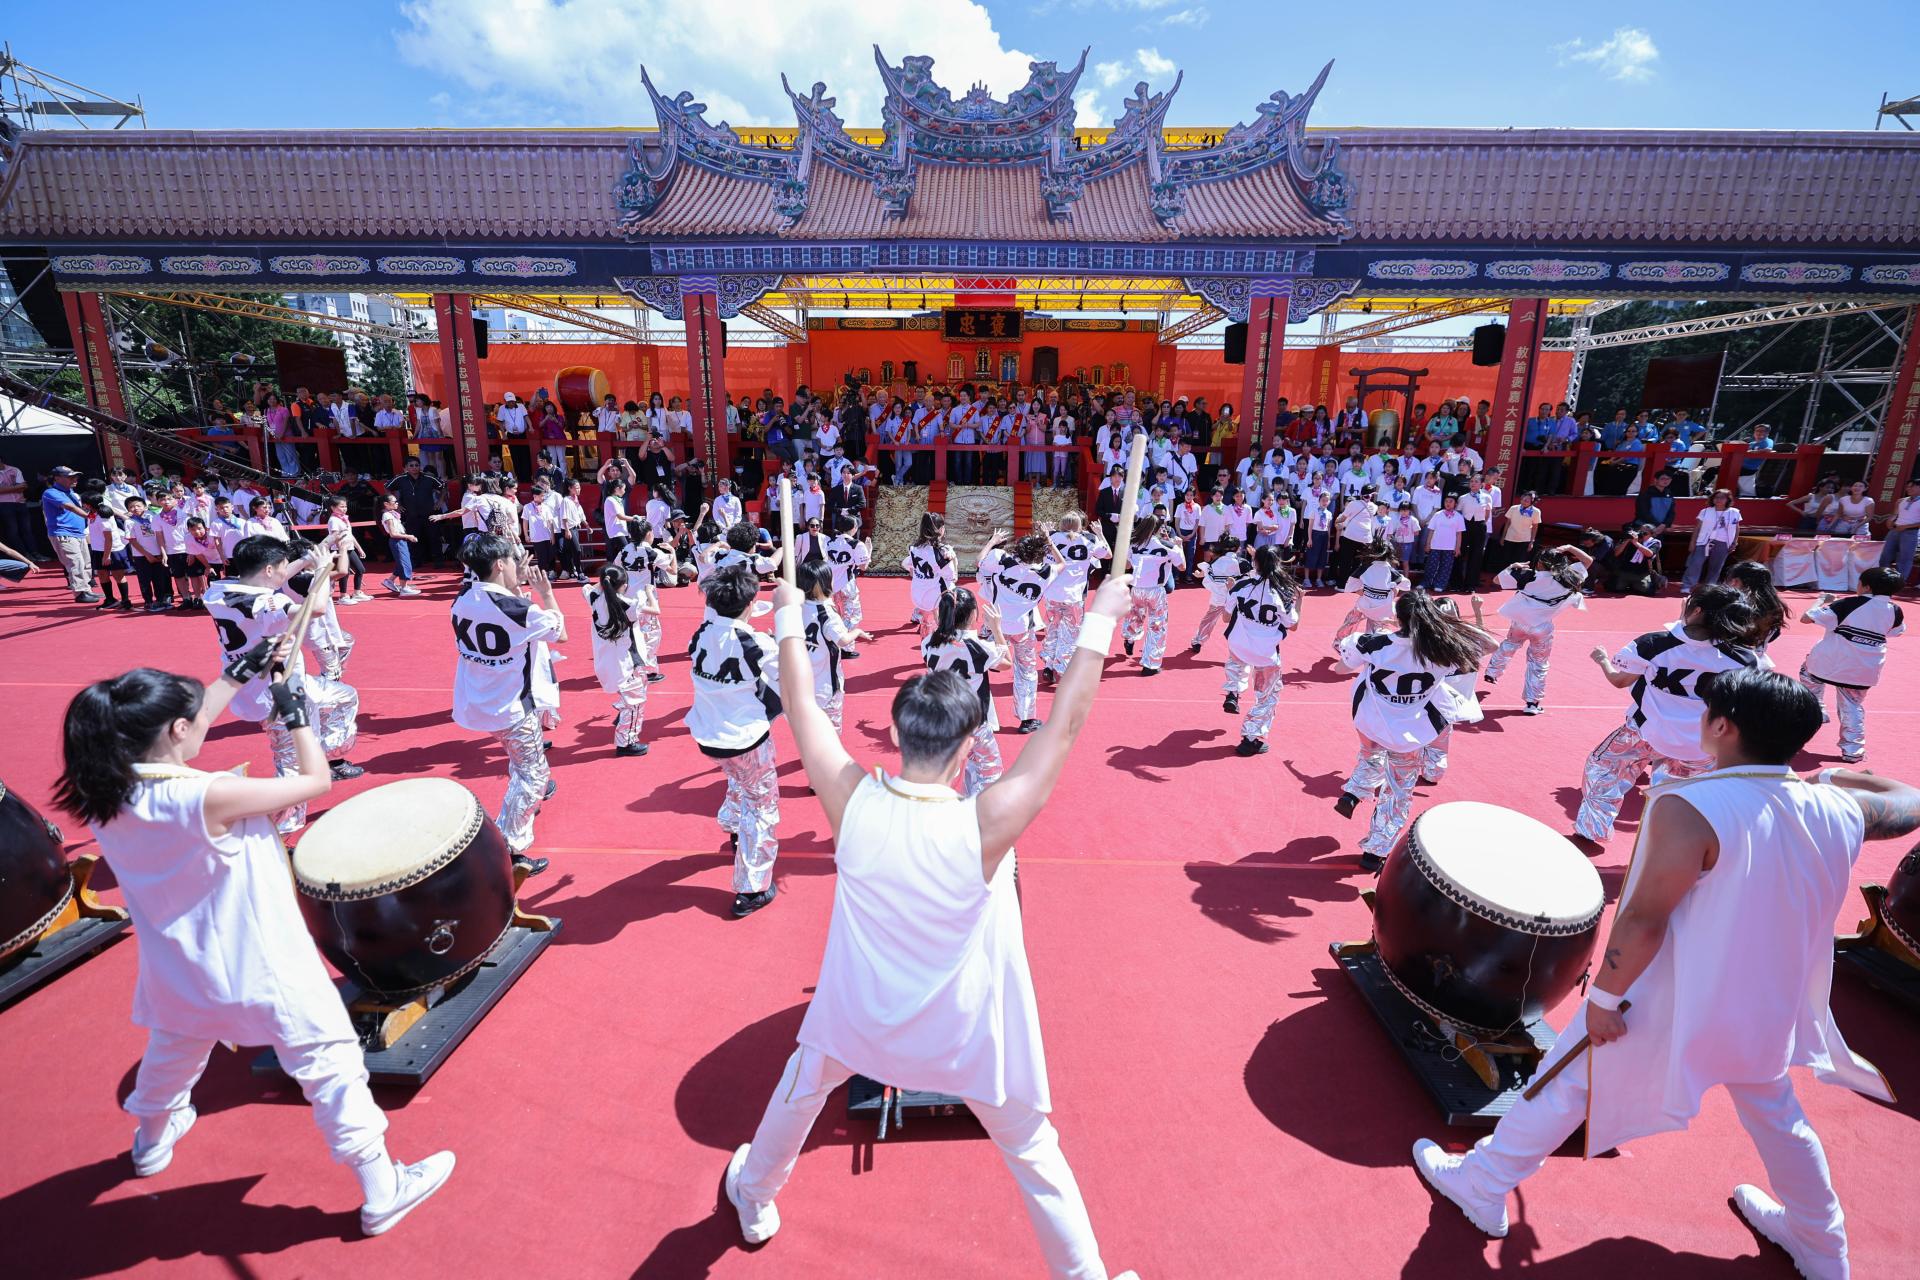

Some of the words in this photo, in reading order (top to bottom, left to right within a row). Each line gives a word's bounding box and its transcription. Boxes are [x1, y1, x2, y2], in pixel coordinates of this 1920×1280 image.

[998, 571, 1042, 601] KO
[1236, 595, 1278, 624] KO
[452, 613, 511, 657] KO
[805, 622, 819, 646] A
[1371, 663, 1436, 695] KO
[1391, 695, 1416, 704] GIVE
